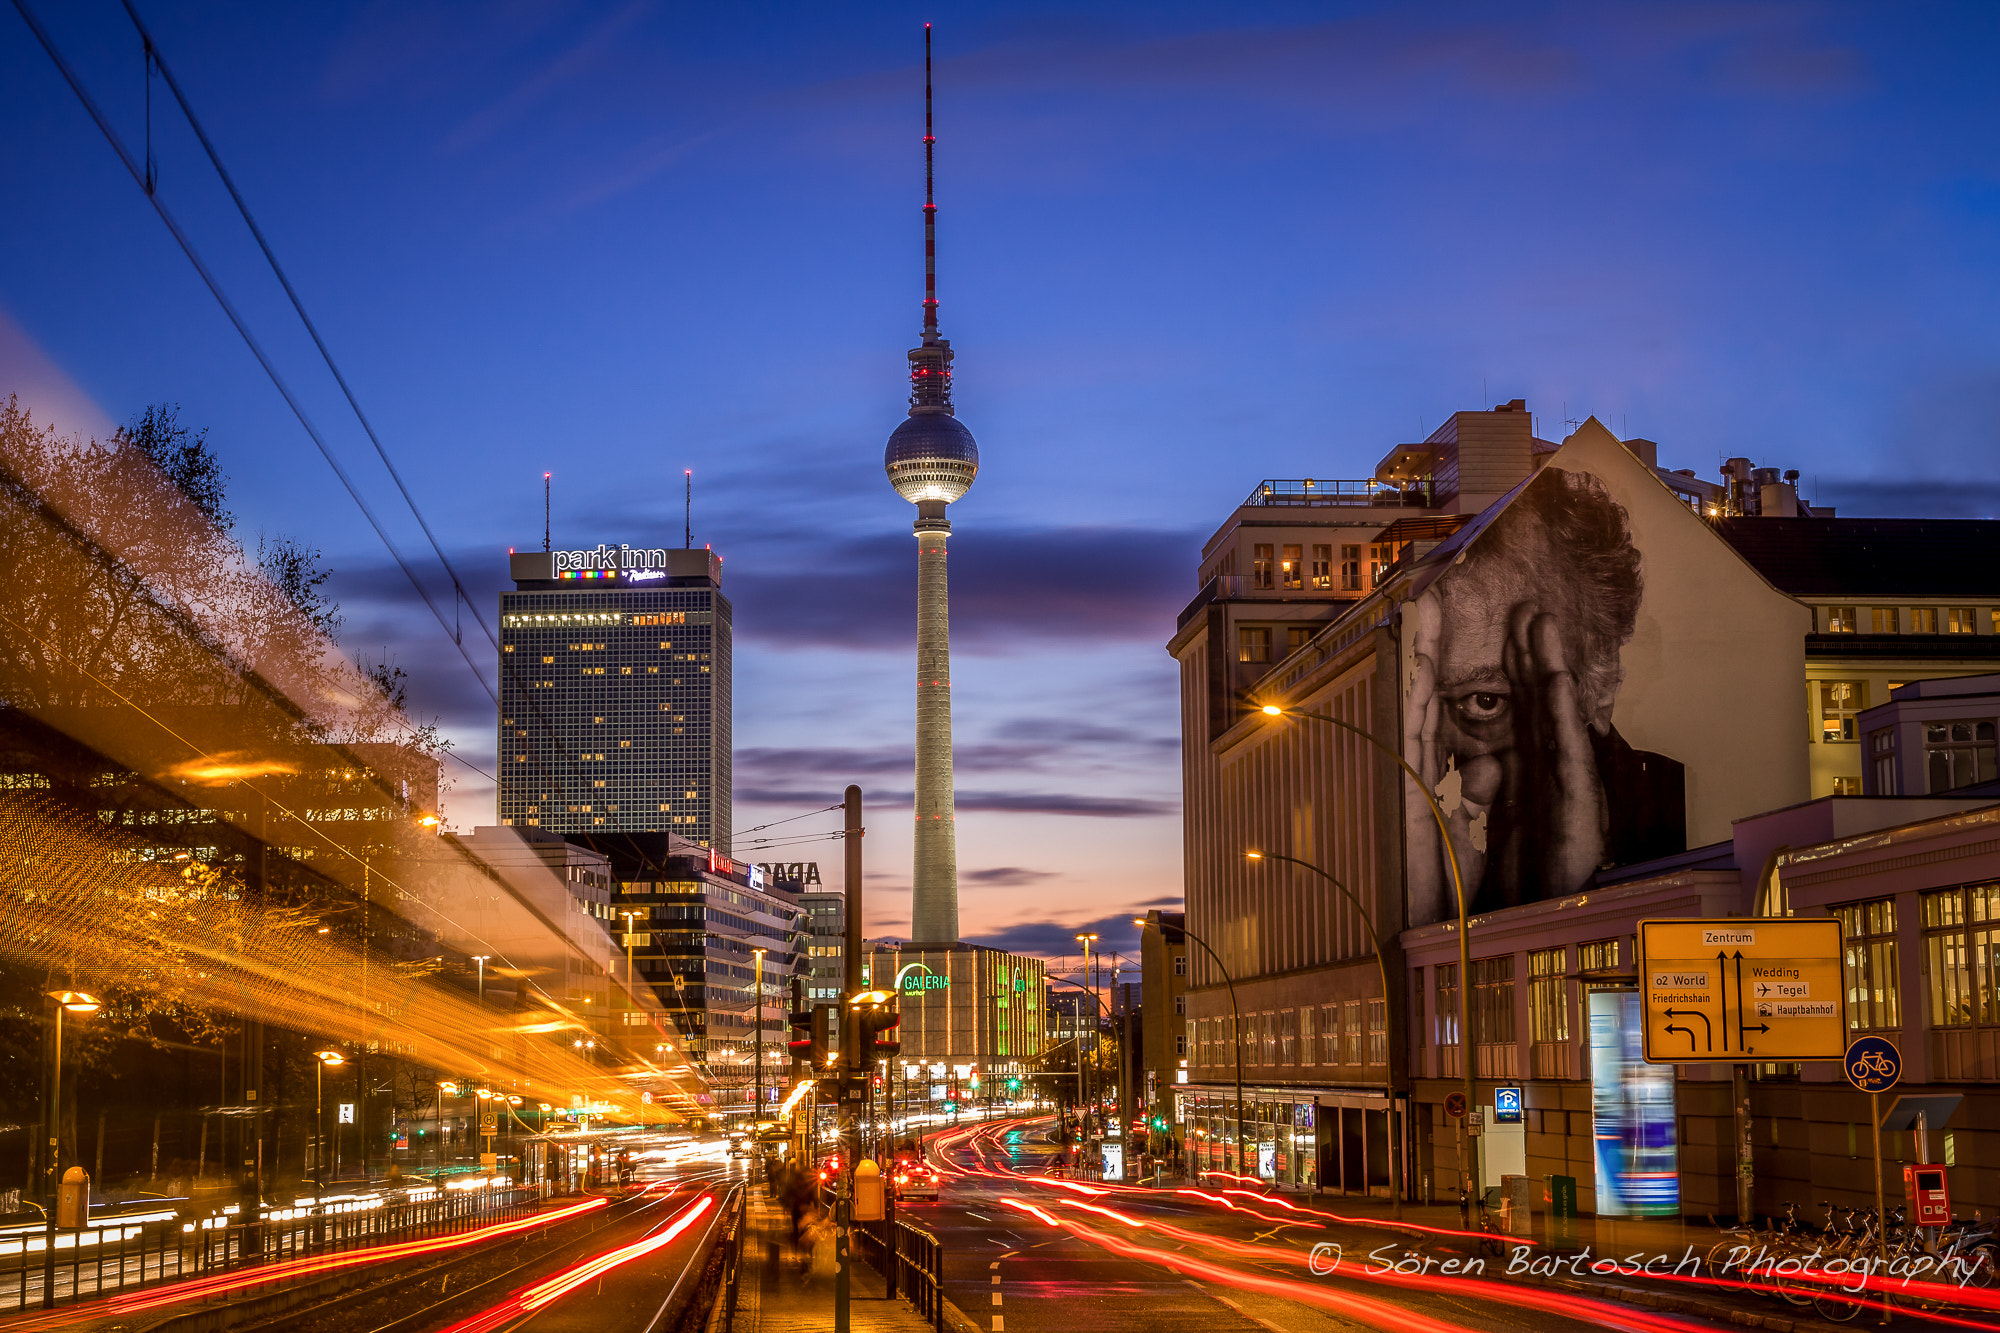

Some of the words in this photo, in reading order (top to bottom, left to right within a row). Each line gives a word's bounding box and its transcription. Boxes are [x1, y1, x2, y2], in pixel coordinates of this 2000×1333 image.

[552, 544, 617, 580] park
[621, 544, 666, 569] inn
[1705, 932, 1753, 943] Zentrum
[1752, 967, 1800, 979] Wedding
[904, 975, 951, 990] GALERIA
[1673, 975, 1706, 986] World
[1777, 985, 1807, 997] Tegel
[1652, 993, 1711, 1003] Friedrichshain
[1777, 1004, 1834, 1017] Hauptbahnhof
[686, 1032, 694, 1041] W
[1504, 1095, 1513, 1108] P
